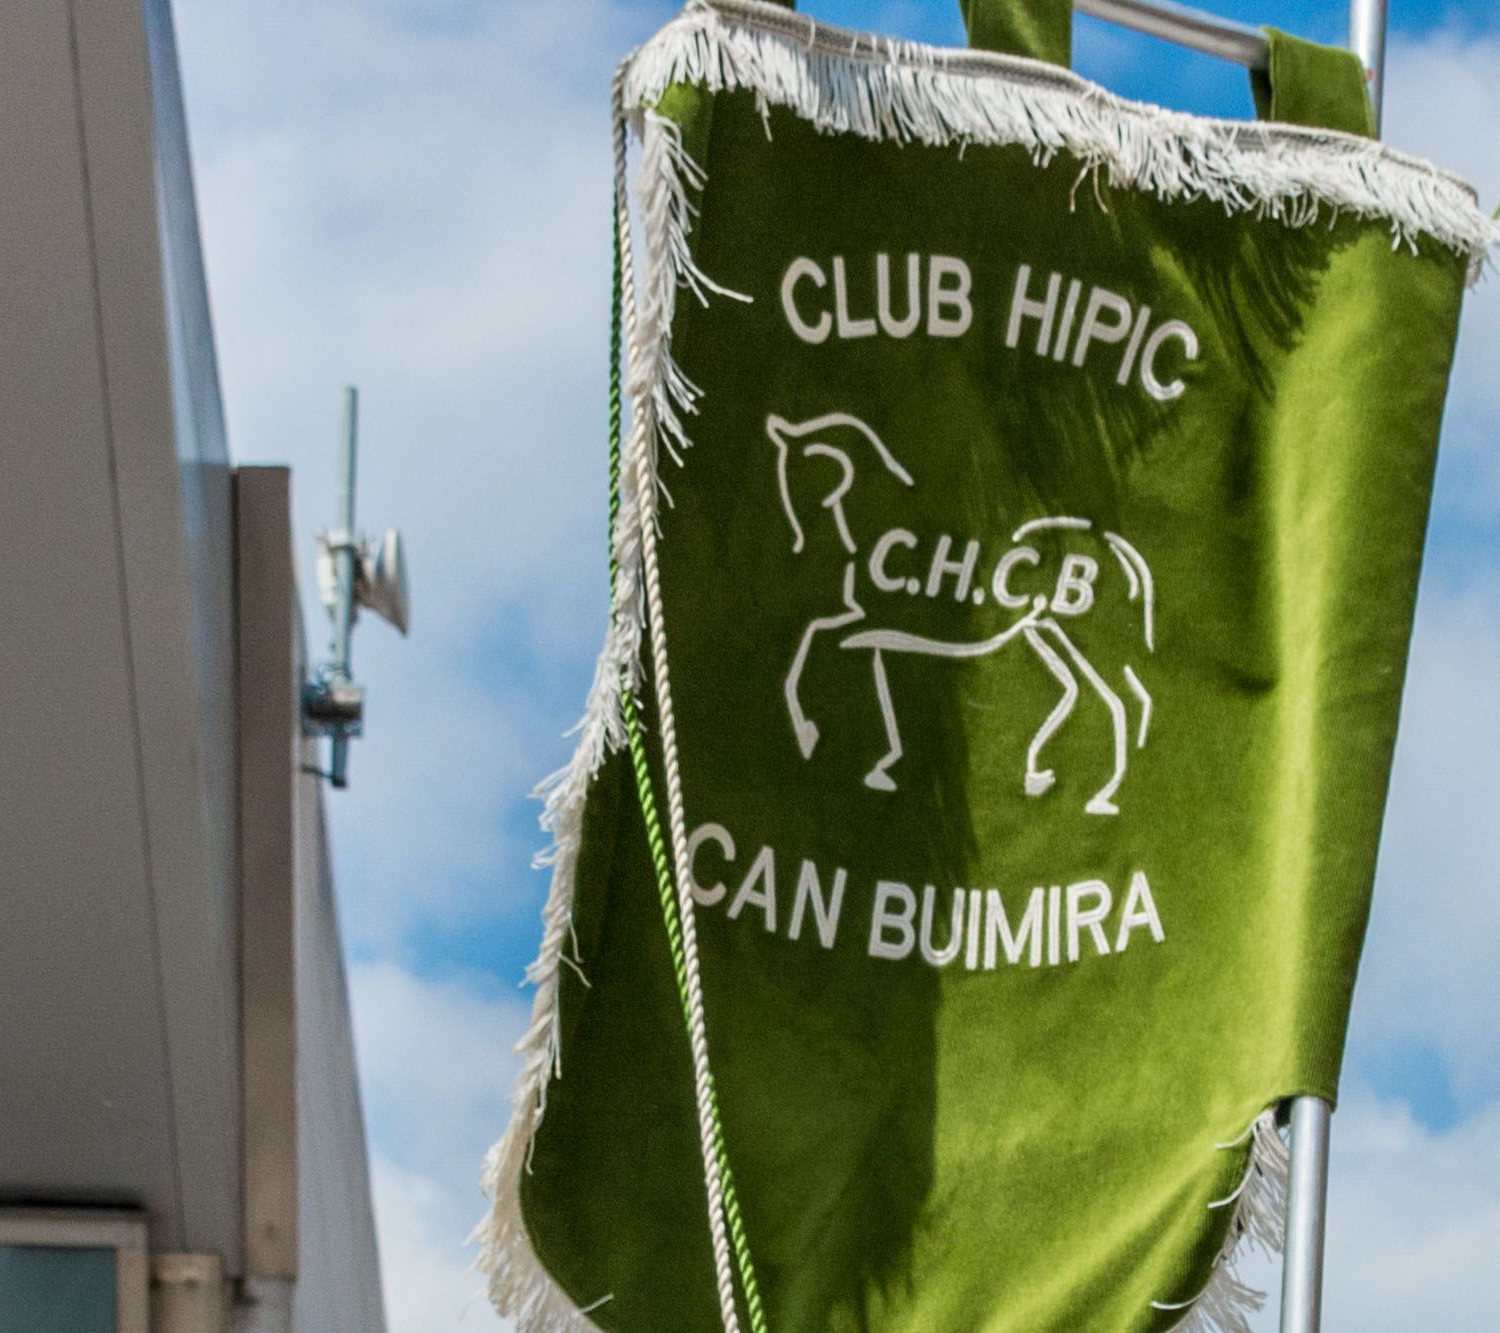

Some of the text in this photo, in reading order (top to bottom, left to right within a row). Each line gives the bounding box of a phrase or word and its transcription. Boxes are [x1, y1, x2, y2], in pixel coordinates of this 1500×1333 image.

[781, 252, 1199, 401] CLUB HIPIC
[868, 528, 1099, 617] C.H.C.B
[685, 822, 1166, 970] CAN BUIMIRA
